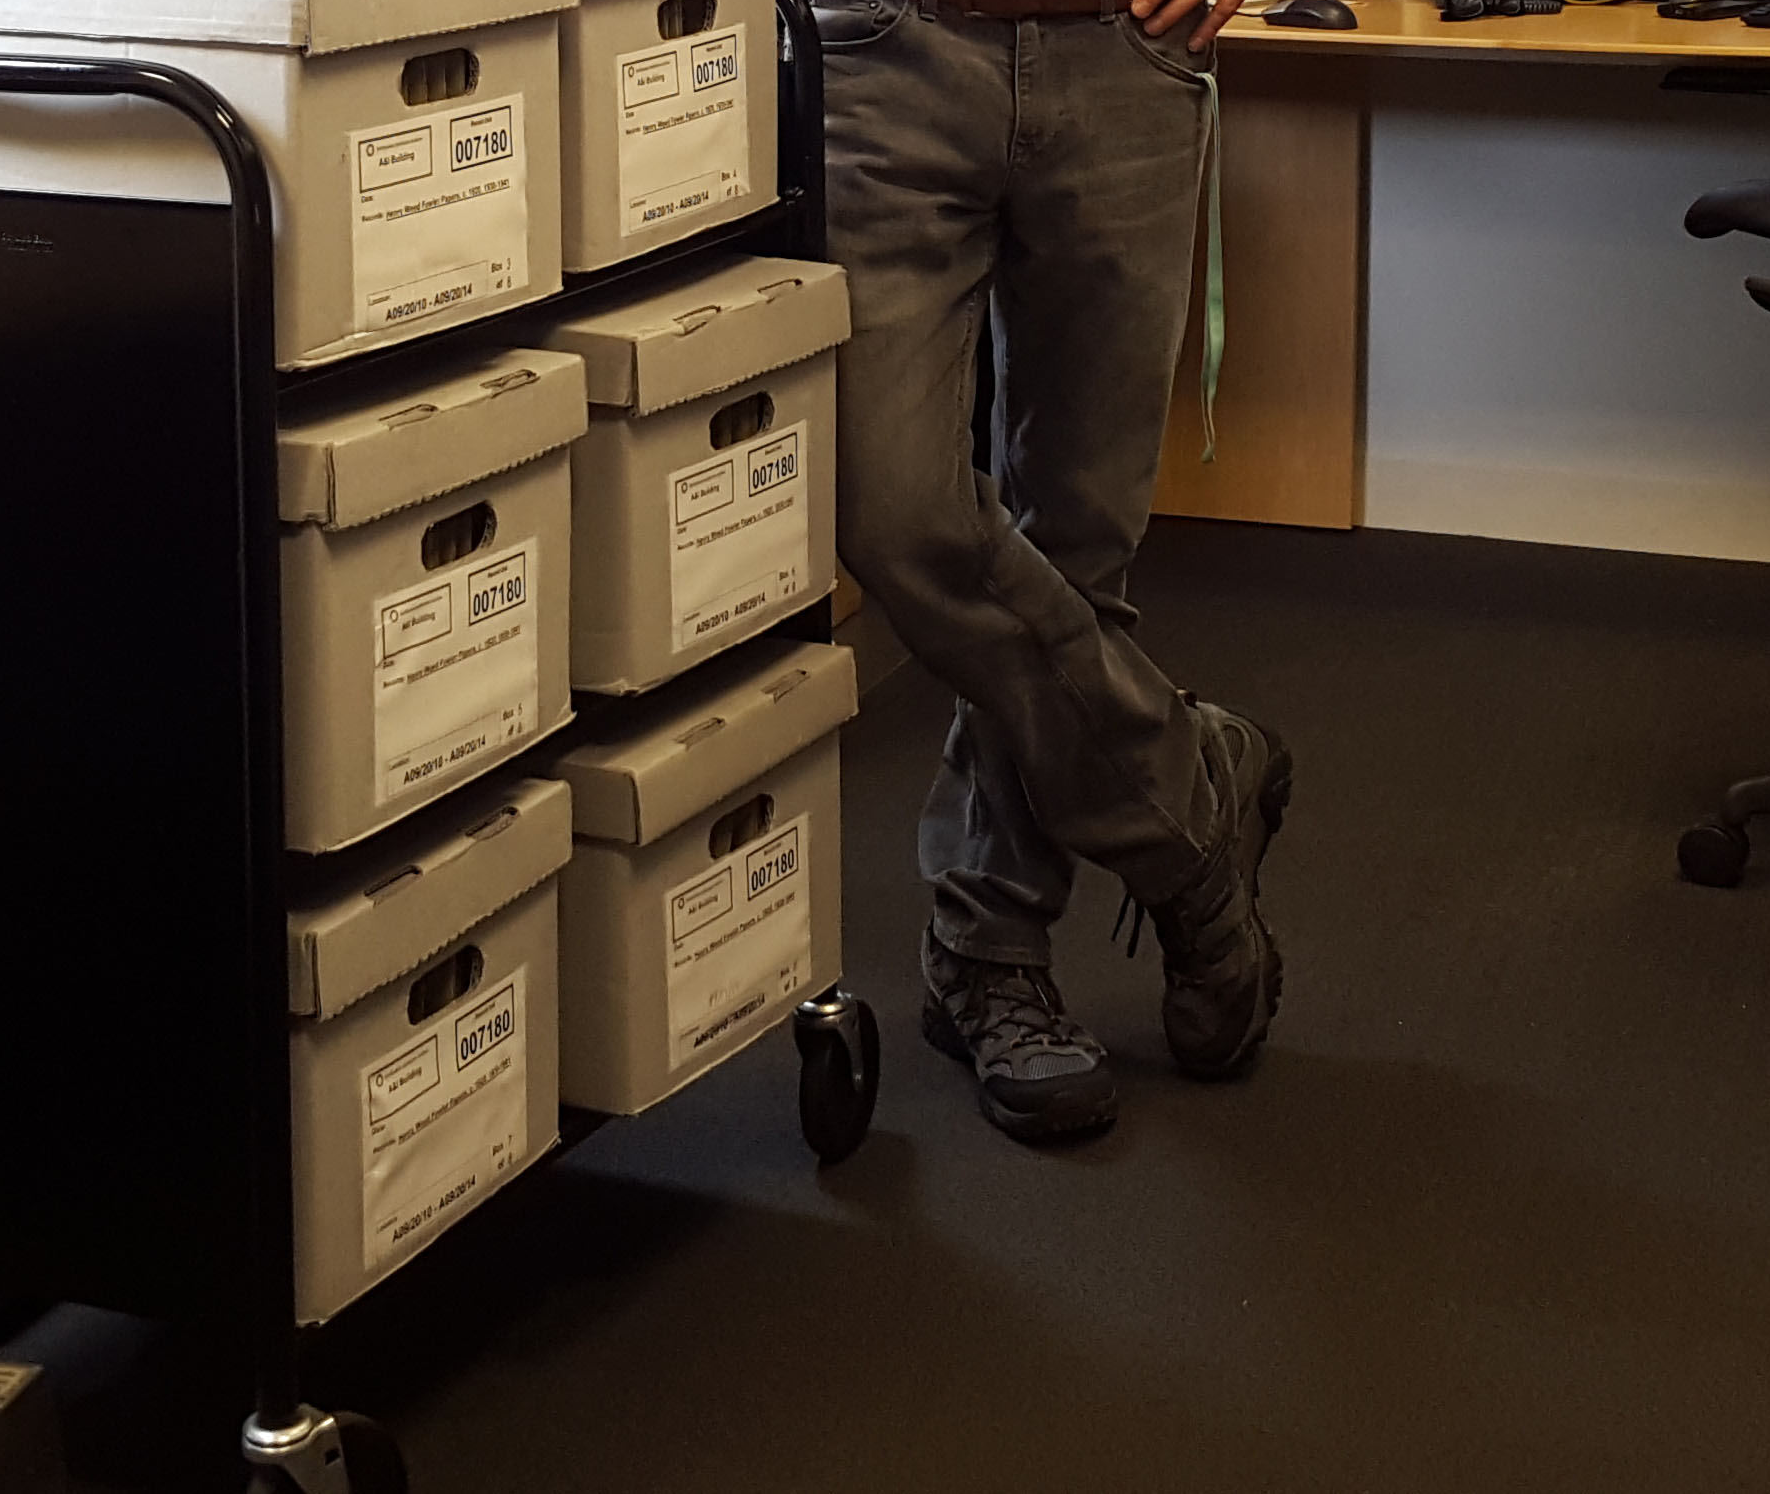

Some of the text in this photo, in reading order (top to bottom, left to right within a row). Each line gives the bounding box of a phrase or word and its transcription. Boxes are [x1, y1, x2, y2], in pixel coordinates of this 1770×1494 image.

[696, 55, 734, 85] 007180
[391, 152, 415, 165] Building
[456, 129, 508, 163] 007180
[752, 453, 794, 489] 007180
[473, 576, 521, 616] 007180
[751, 849, 795, 891] 007180
[460, 1009, 510, 1060] 007180
